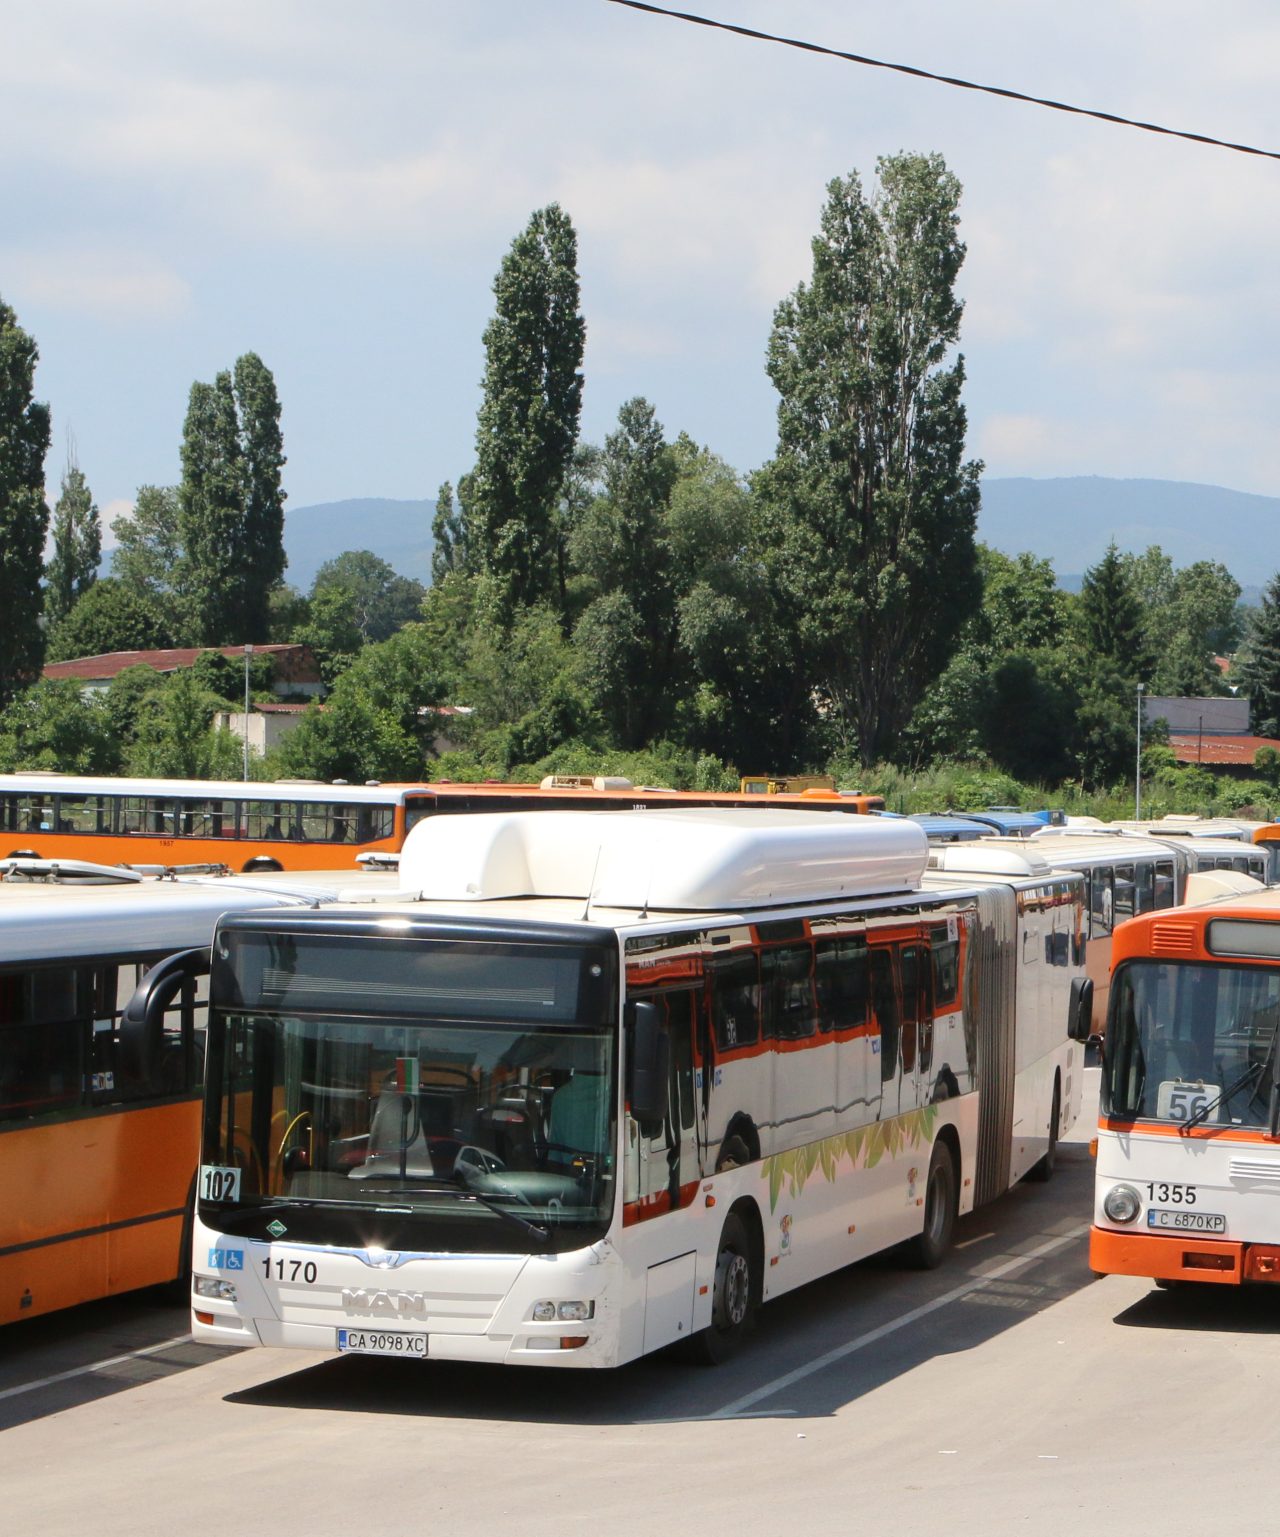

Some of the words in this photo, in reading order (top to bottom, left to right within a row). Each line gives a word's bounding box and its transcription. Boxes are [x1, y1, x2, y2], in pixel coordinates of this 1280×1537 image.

[1169, 1094, 1209, 1122] 56
[205, 1170, 236, 1201] 102
[1146, 1182, 1197, 1205] 1355
[1160, 1213, 1168, 1225] C
[1174, 1214, 1204, 1228] 6870
[261, 1257, 318, 1284] 1170
[341, 1288, 427, 1314] MAN
[348, 1333, 366, 1348] CA
[369, 1334, 403, 1350] 9098
[406, 1337, 424, 1352] XC
